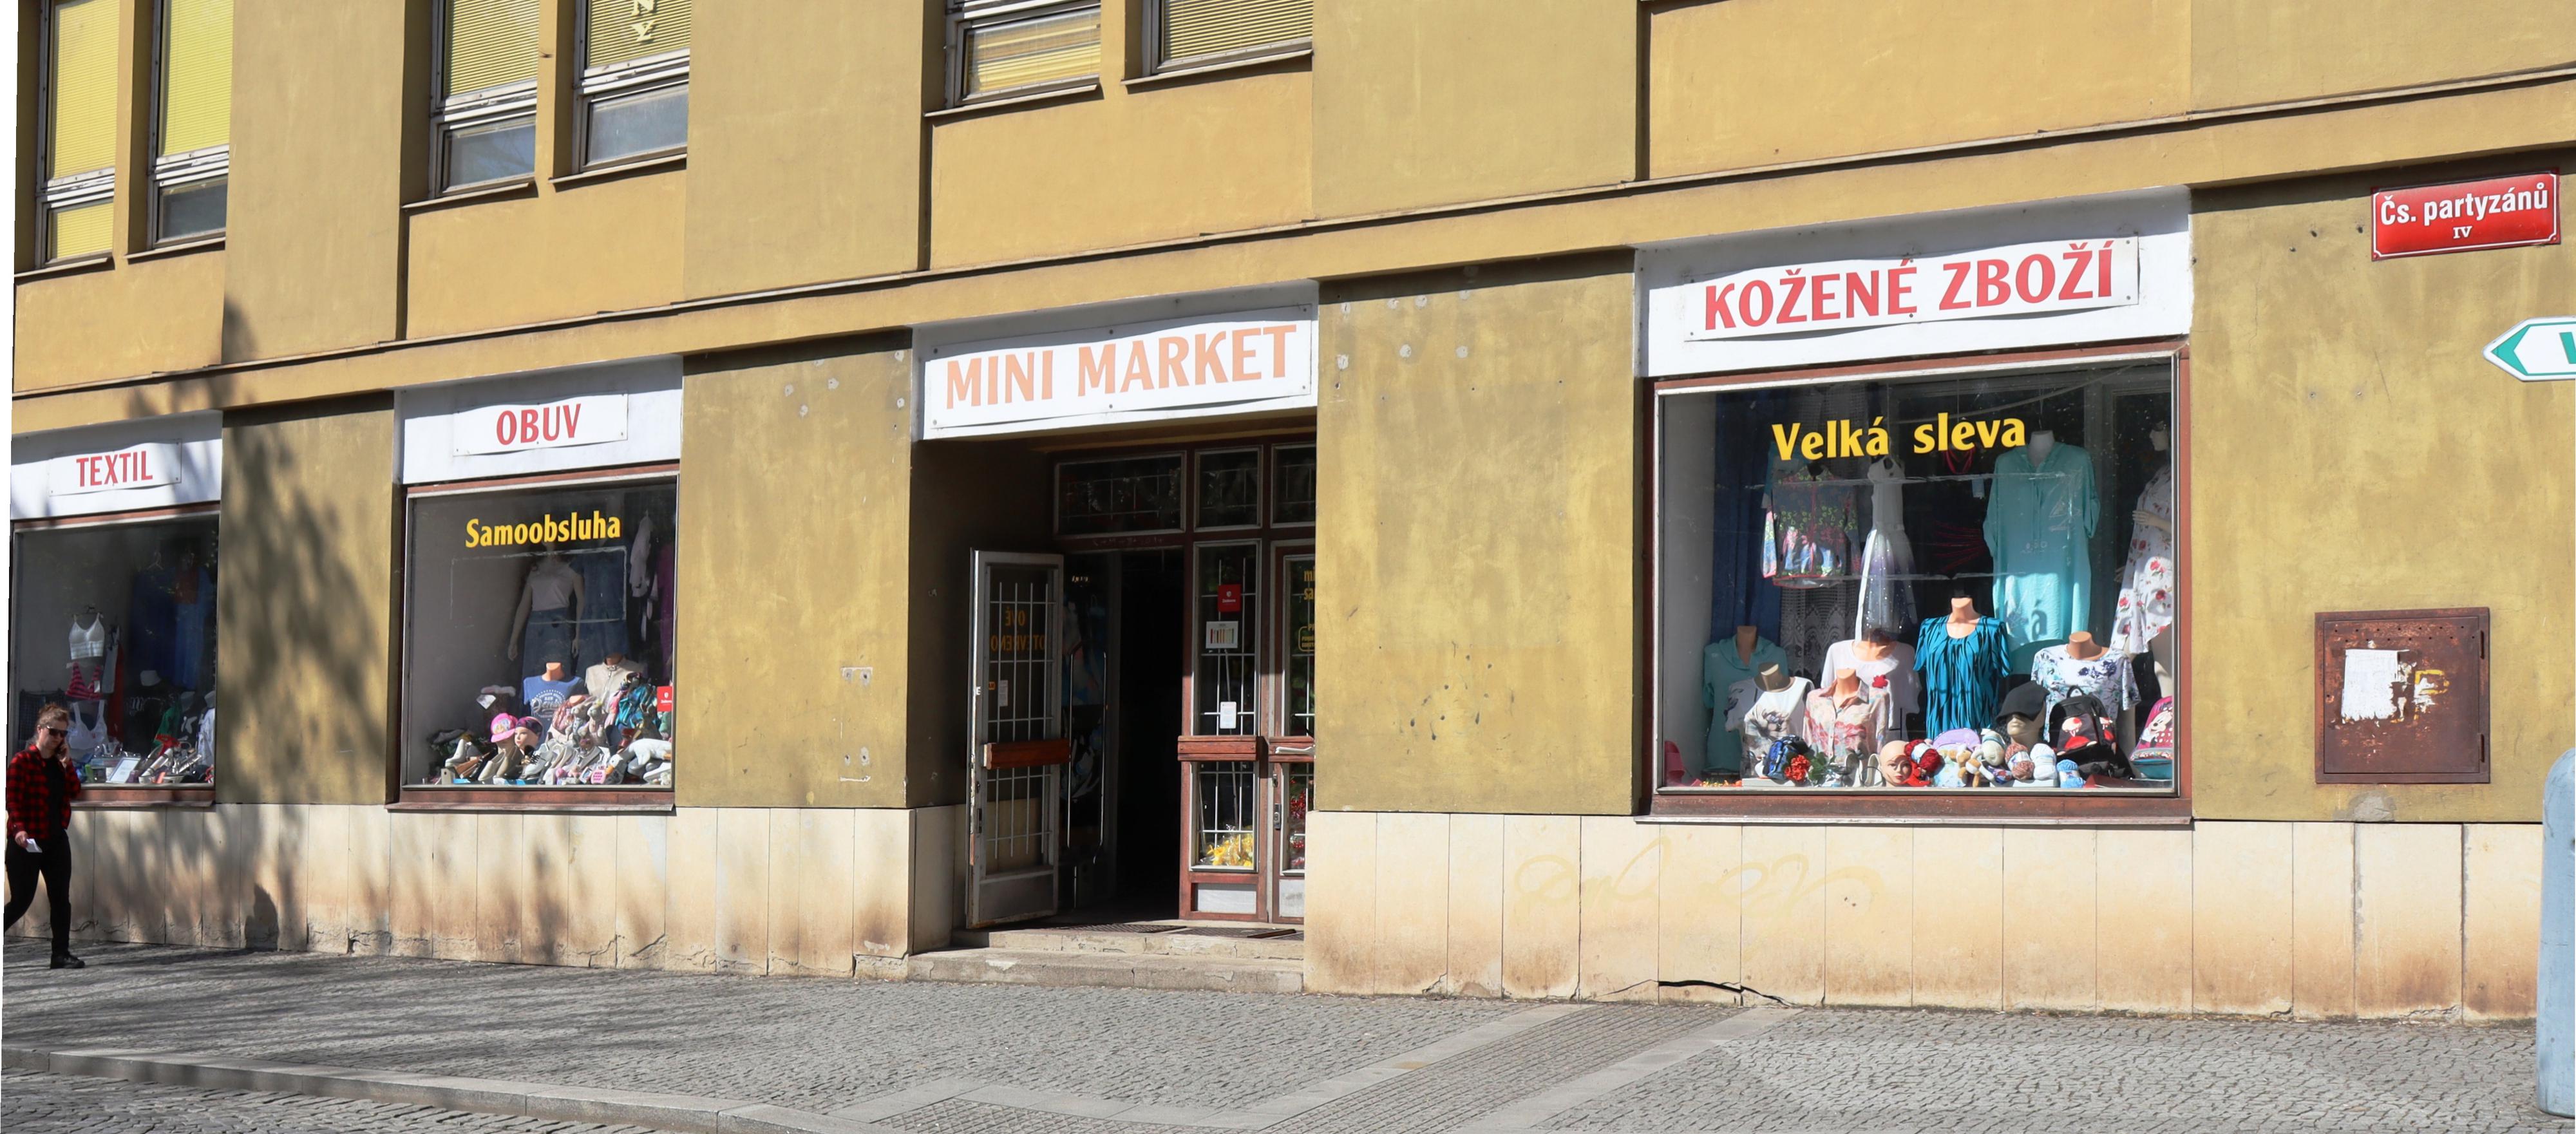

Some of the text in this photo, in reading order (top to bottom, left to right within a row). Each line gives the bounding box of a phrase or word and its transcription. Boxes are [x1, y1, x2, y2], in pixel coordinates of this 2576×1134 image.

[2380, 182, 2548, 226] Čs. partyzánů
[2453, 225, 2473, 239] IV
[1705, 240, 2113, 330] KOŽENÉ ZBOŽÍ
[947, 324, 1297, 410] MINI MARKET
[497, 404, 581, 446] OBUV
[1772, 412, 2026, 460] Velká sleva
[76, 451, 153, 487] TEXTIL
[465, 511, 621, 548] Samoobsluha
